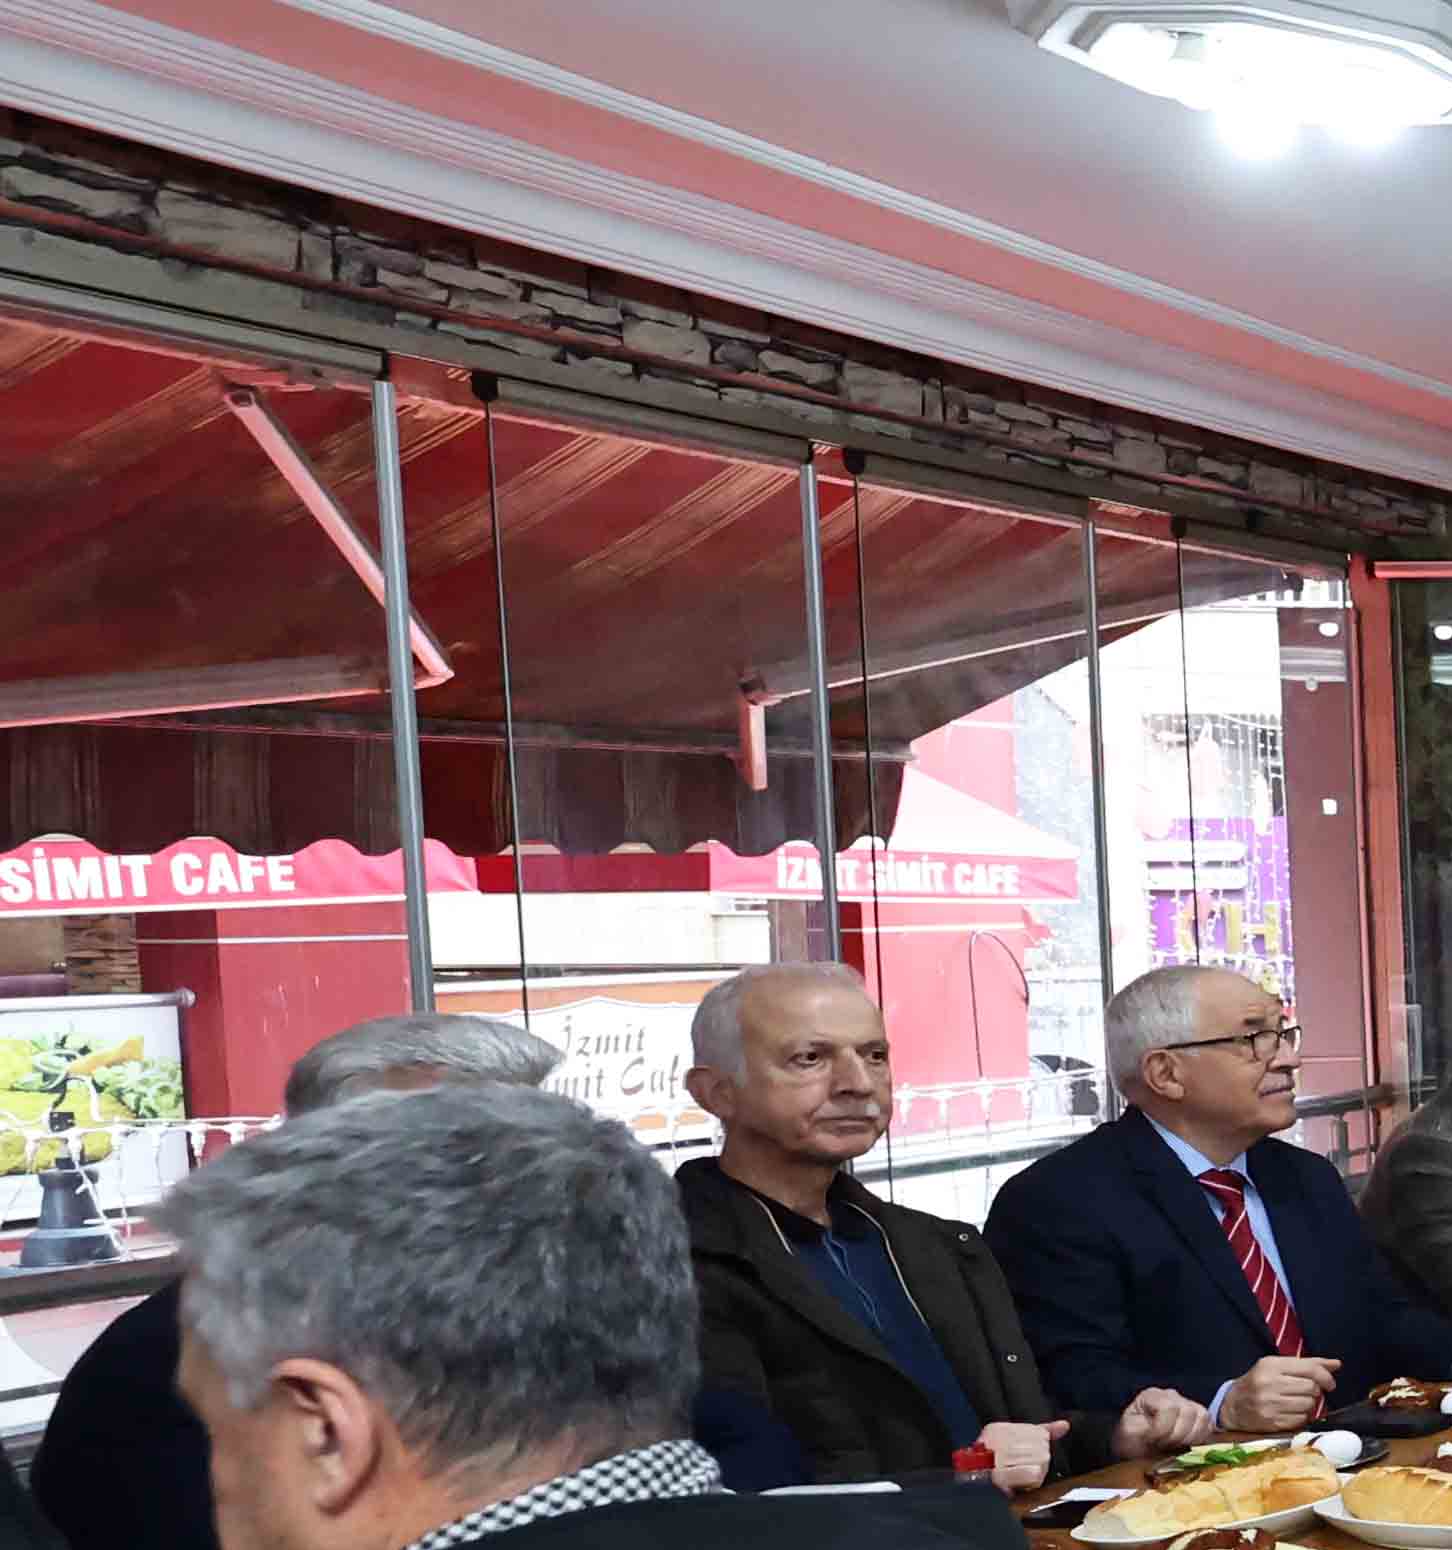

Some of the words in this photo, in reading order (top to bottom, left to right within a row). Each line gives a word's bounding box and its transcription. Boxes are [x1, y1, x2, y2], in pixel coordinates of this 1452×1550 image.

[169, 853, 297, 897] CAFE
[954, 862, 1020, 895] CAFE
[620, 1055, 680, 1100] Caf
